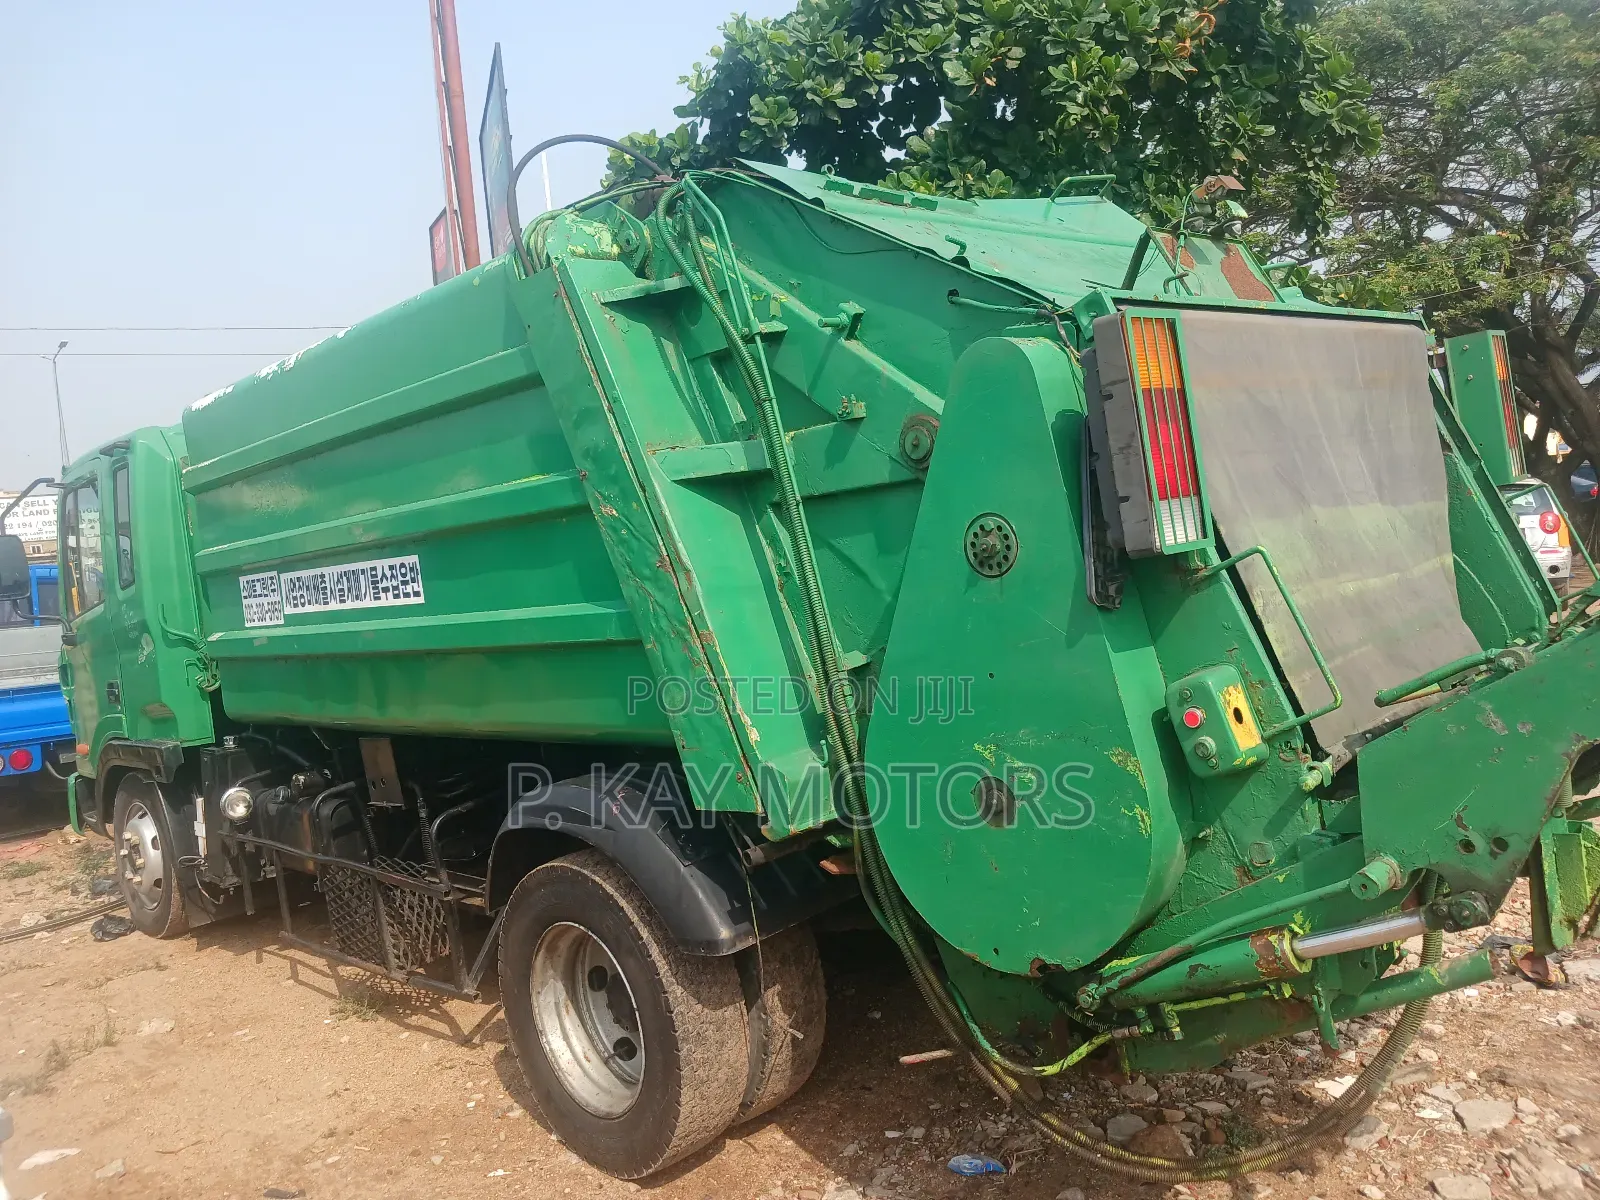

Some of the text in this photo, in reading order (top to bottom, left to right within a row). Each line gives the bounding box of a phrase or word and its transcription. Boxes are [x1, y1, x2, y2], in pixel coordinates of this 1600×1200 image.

[0, 502, 20, 510] CA
[24, 499, 49, 508] SELL
[22, 508, 50, 517] LAND
[17, 521, 33, 529] 194
